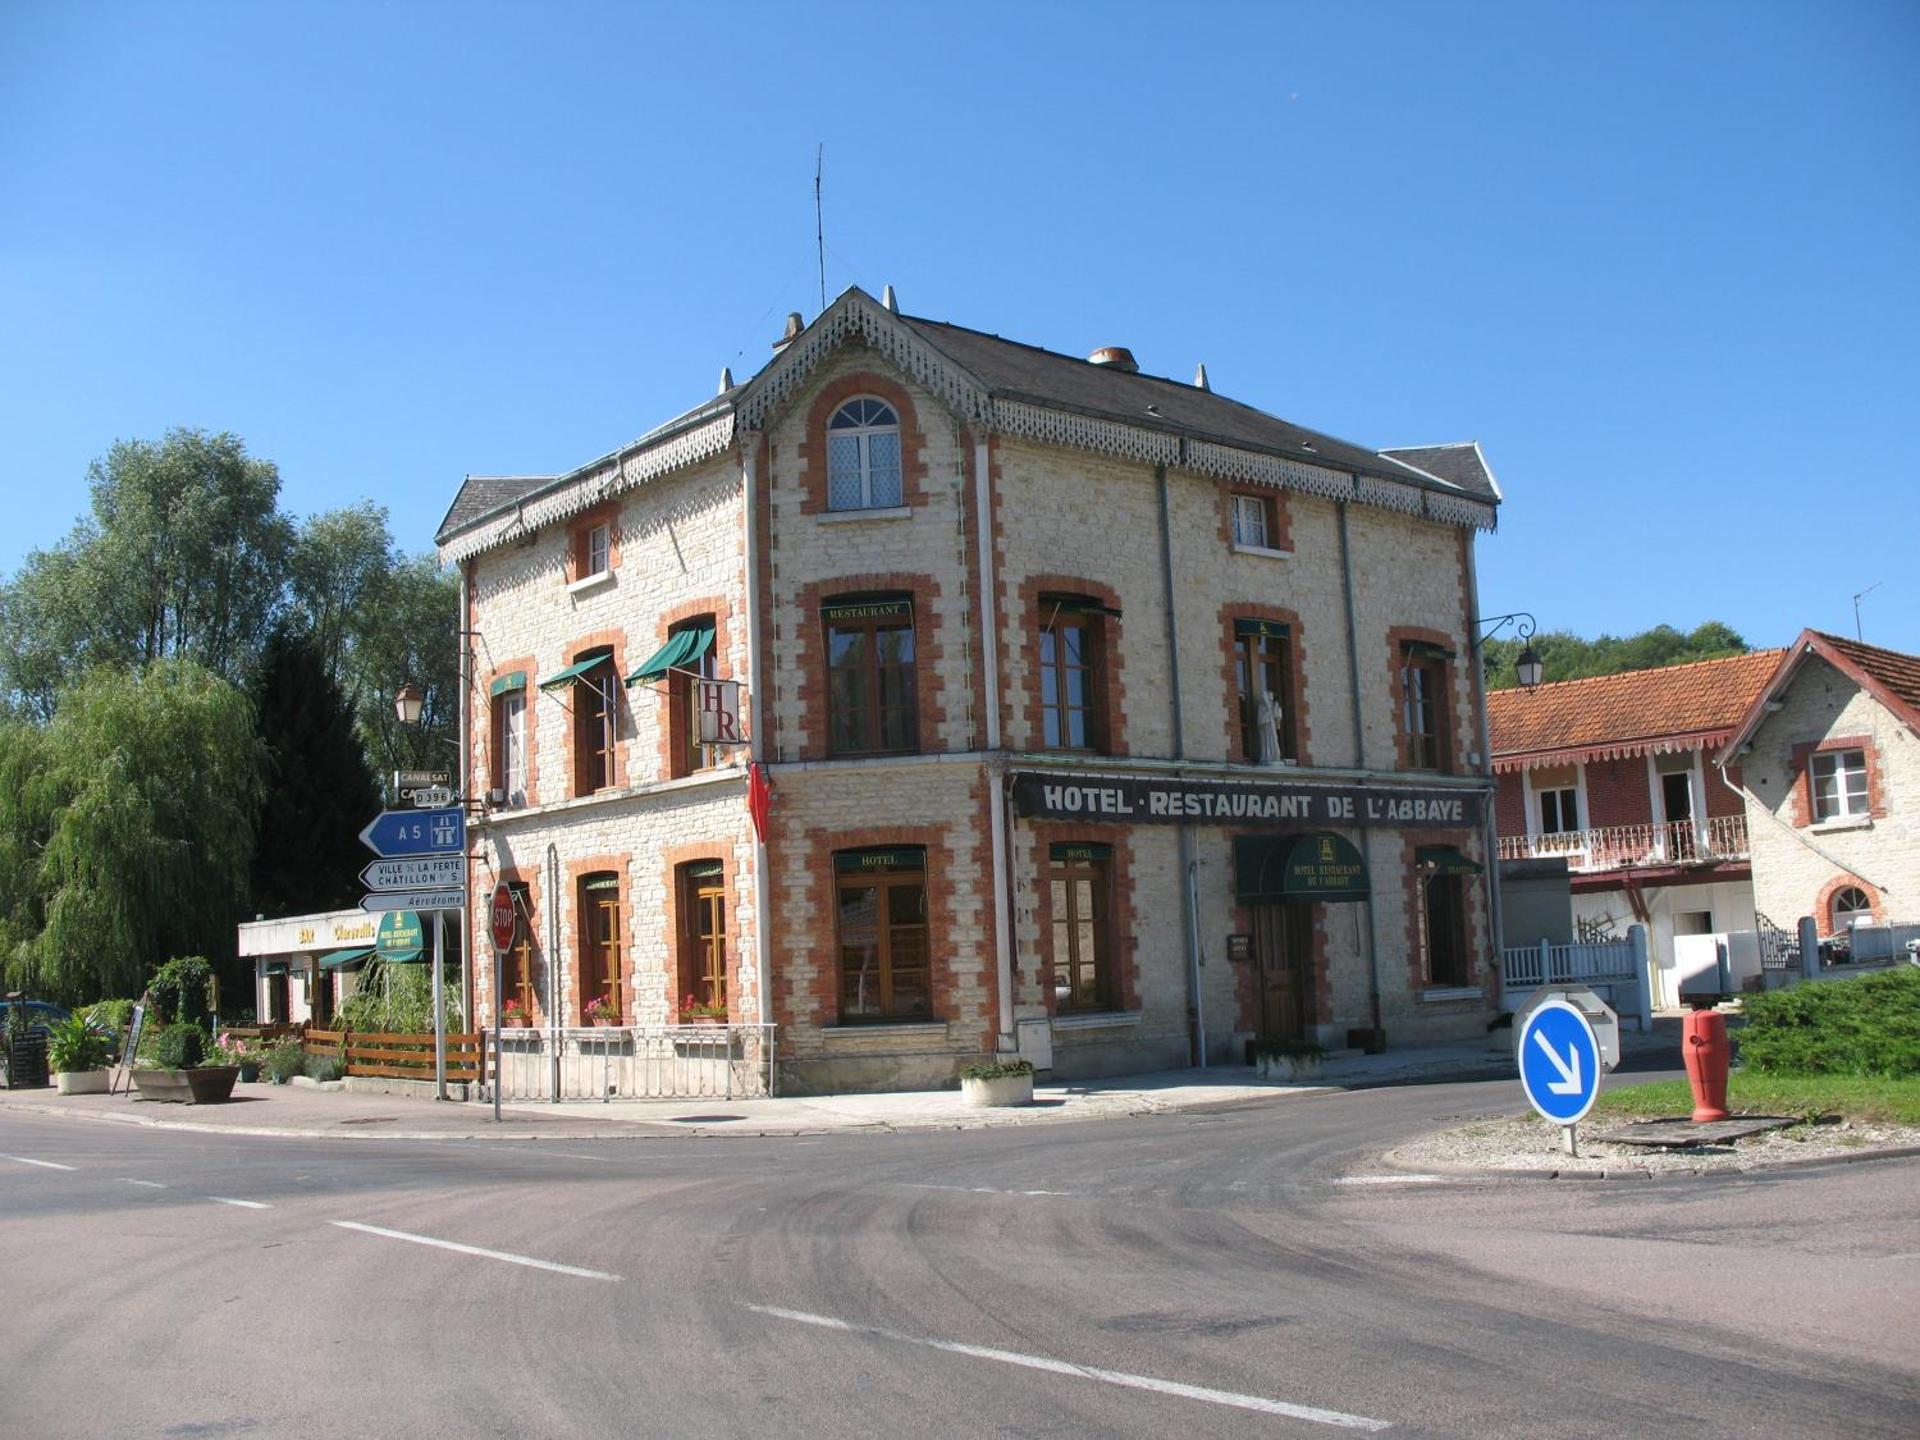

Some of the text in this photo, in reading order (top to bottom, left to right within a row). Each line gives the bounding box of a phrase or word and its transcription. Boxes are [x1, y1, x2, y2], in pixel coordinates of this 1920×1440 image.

[830, 605, 899, 619] RESTAURANT
[426, 793, 447, 803] 396
[1044, 785, 1463, 821] HOTEL RESTAURANT DE L'ABBAYE
[399, 825, 421, 841] A 5
[1067, 848, 1092, 858] HOTEL
[862, 854, 898, 866] HOTEL
[378, 864, 402, 874] VILLE
[418, 862, 429, 872] LA
[408, 896, 461, 906] Aérodrome
[494, 908, 513, 928] STOP
